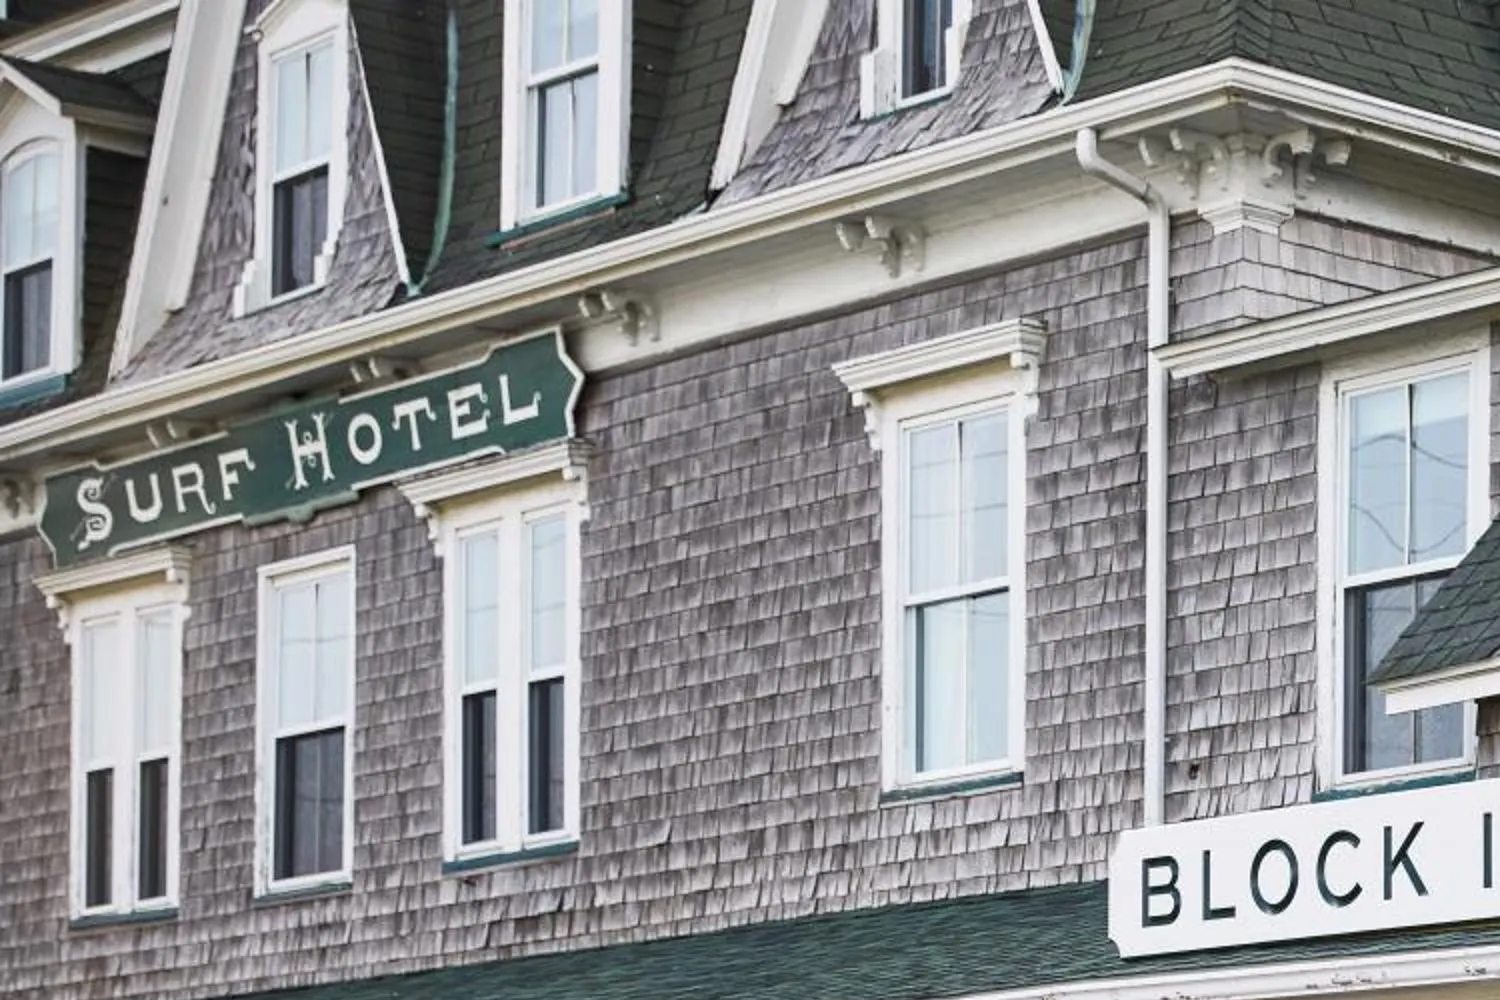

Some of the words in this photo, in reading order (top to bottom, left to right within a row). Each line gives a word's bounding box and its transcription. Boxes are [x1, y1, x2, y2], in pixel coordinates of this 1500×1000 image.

[75, 447, 256, 551] SURF
[284, 373, 542, 491] HOTEL
[1140, 821, 1429, 929] BLOCK
